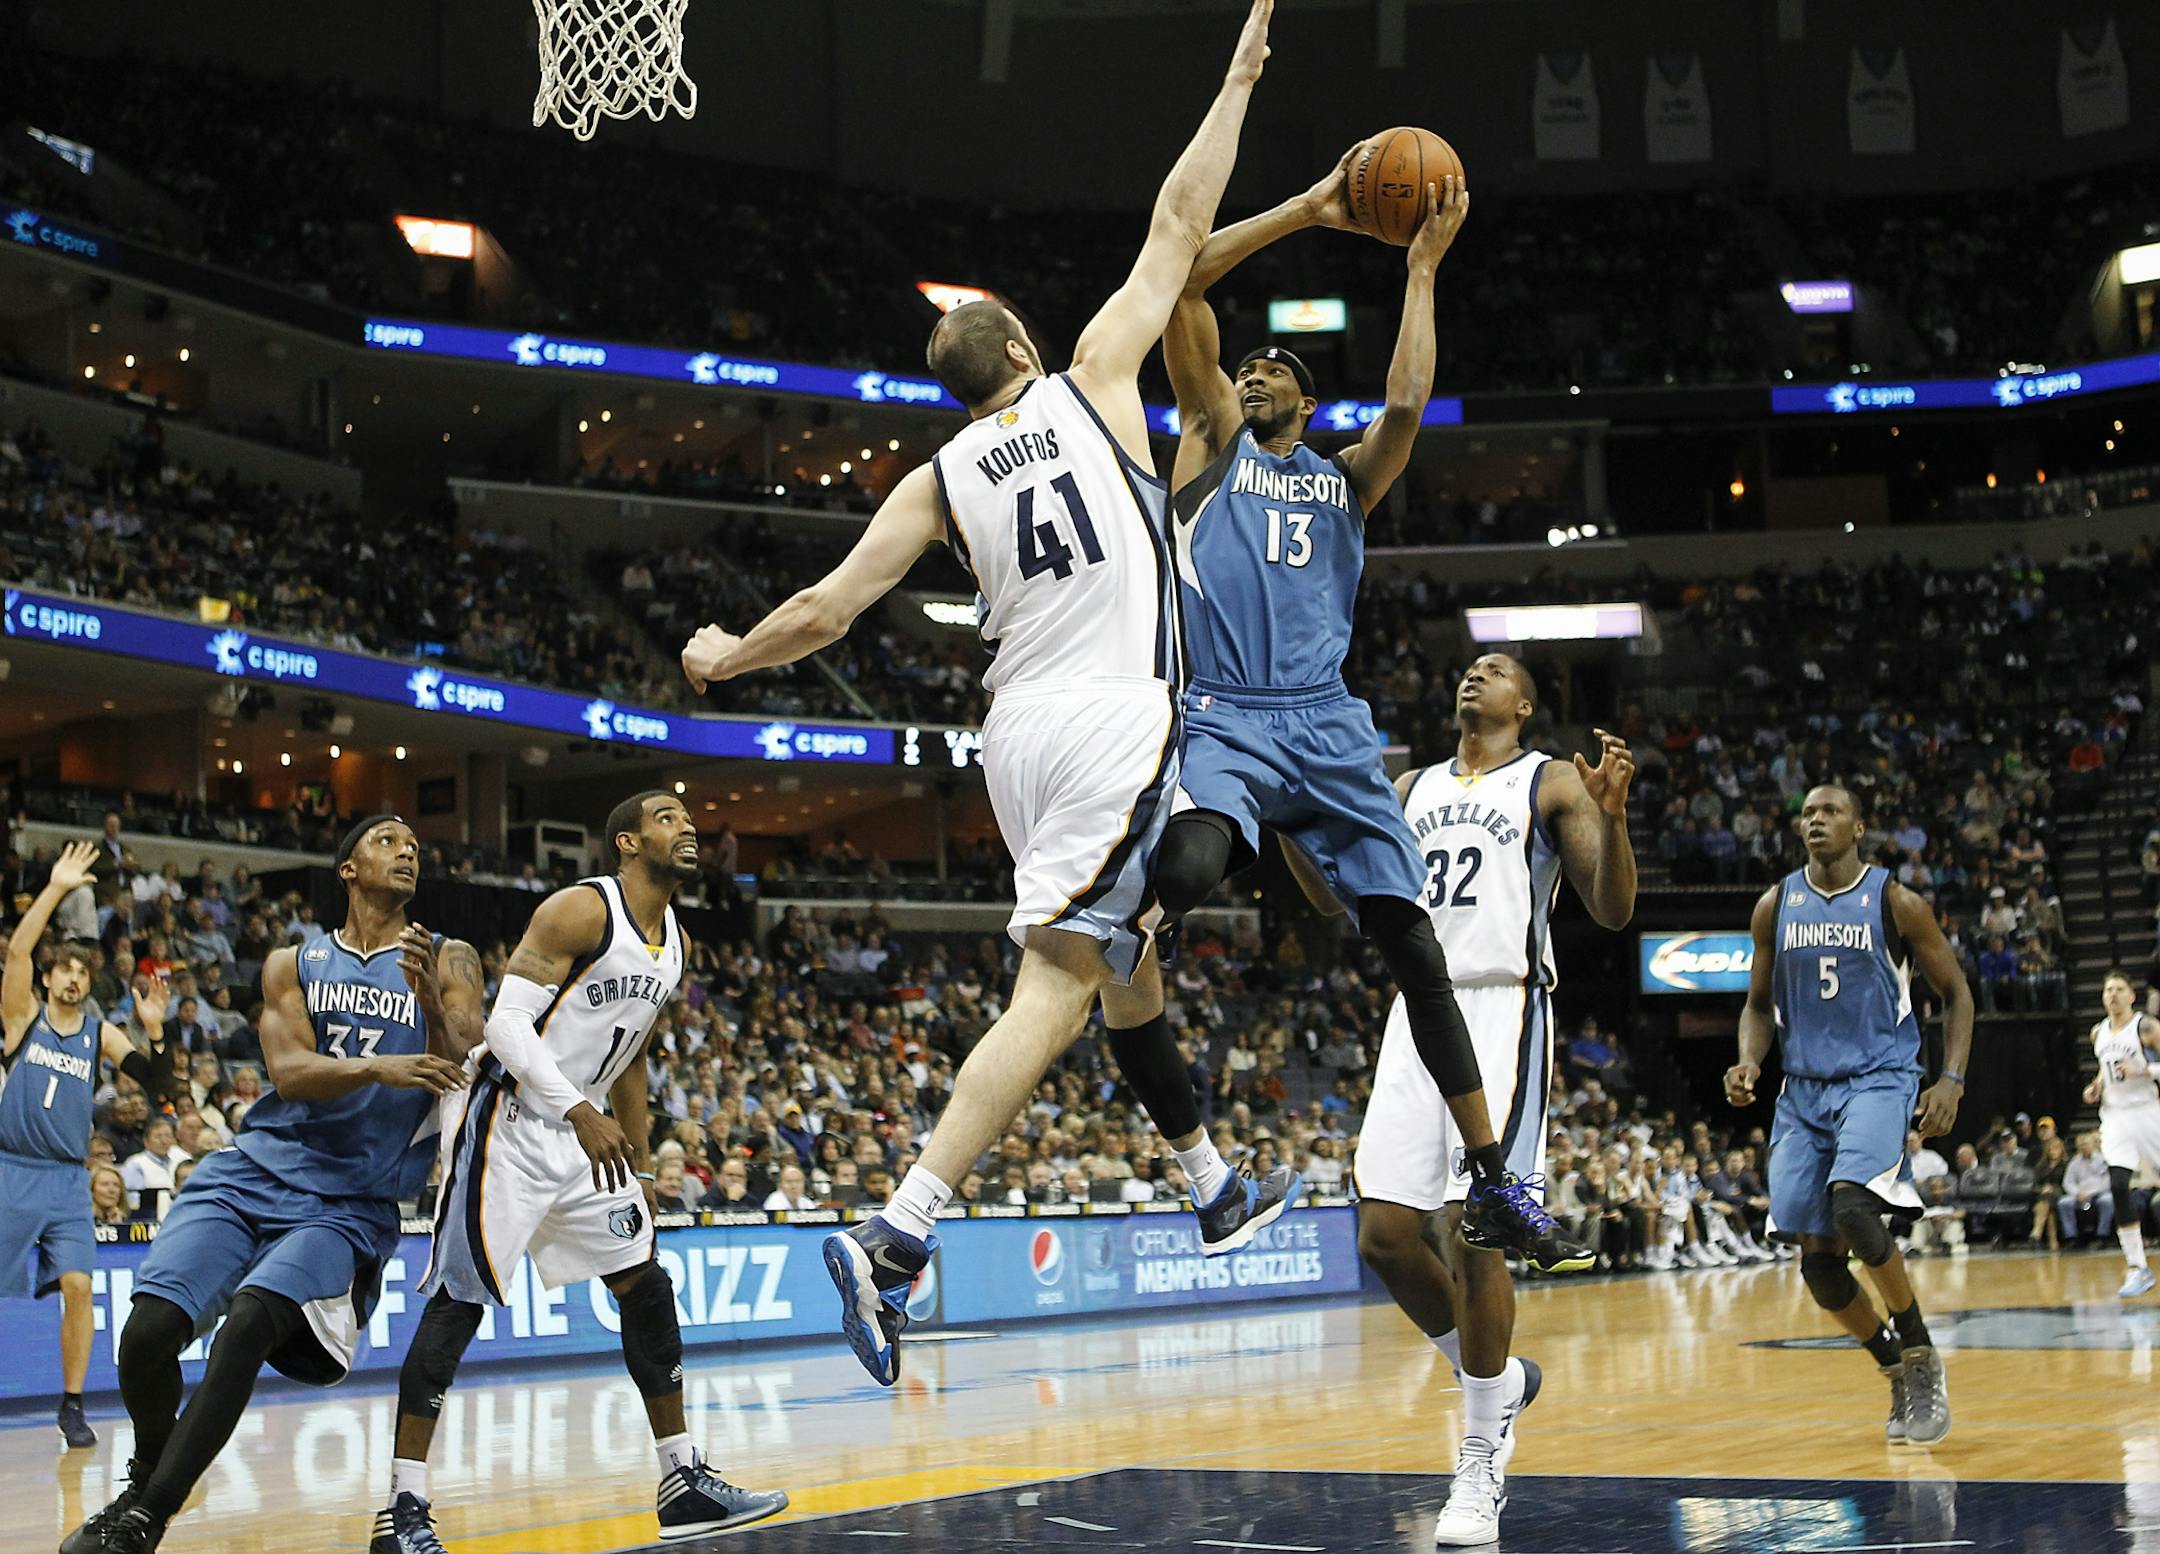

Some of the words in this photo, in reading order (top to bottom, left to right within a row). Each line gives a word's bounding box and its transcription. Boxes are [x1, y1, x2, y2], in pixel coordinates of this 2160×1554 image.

[976, 428, 1060, 487] KOUFOS
[1229, 458, 1350, 514] MINNESOTA
[1017, 470, 1106, 581] 41
[1263, 508, 1315, 568] 13
[1414, 803, 1520, 846] RIZZLIES
[1425, 846, 1482, 908] 32
[1784, 921, 1873, 953] MINNESOTA
[1819, 956, 1840, 1001] 5
[306, 980, 416, 1030] MINNESOTA
[24, 1042, 92, 1083] MINNESOTA
[43, 1074, 59, 1110] 1
[1135, 1256, 1231, 1294] MEMPHIS
[1231, 1250, 1323, 1287] GRIZZLIES
